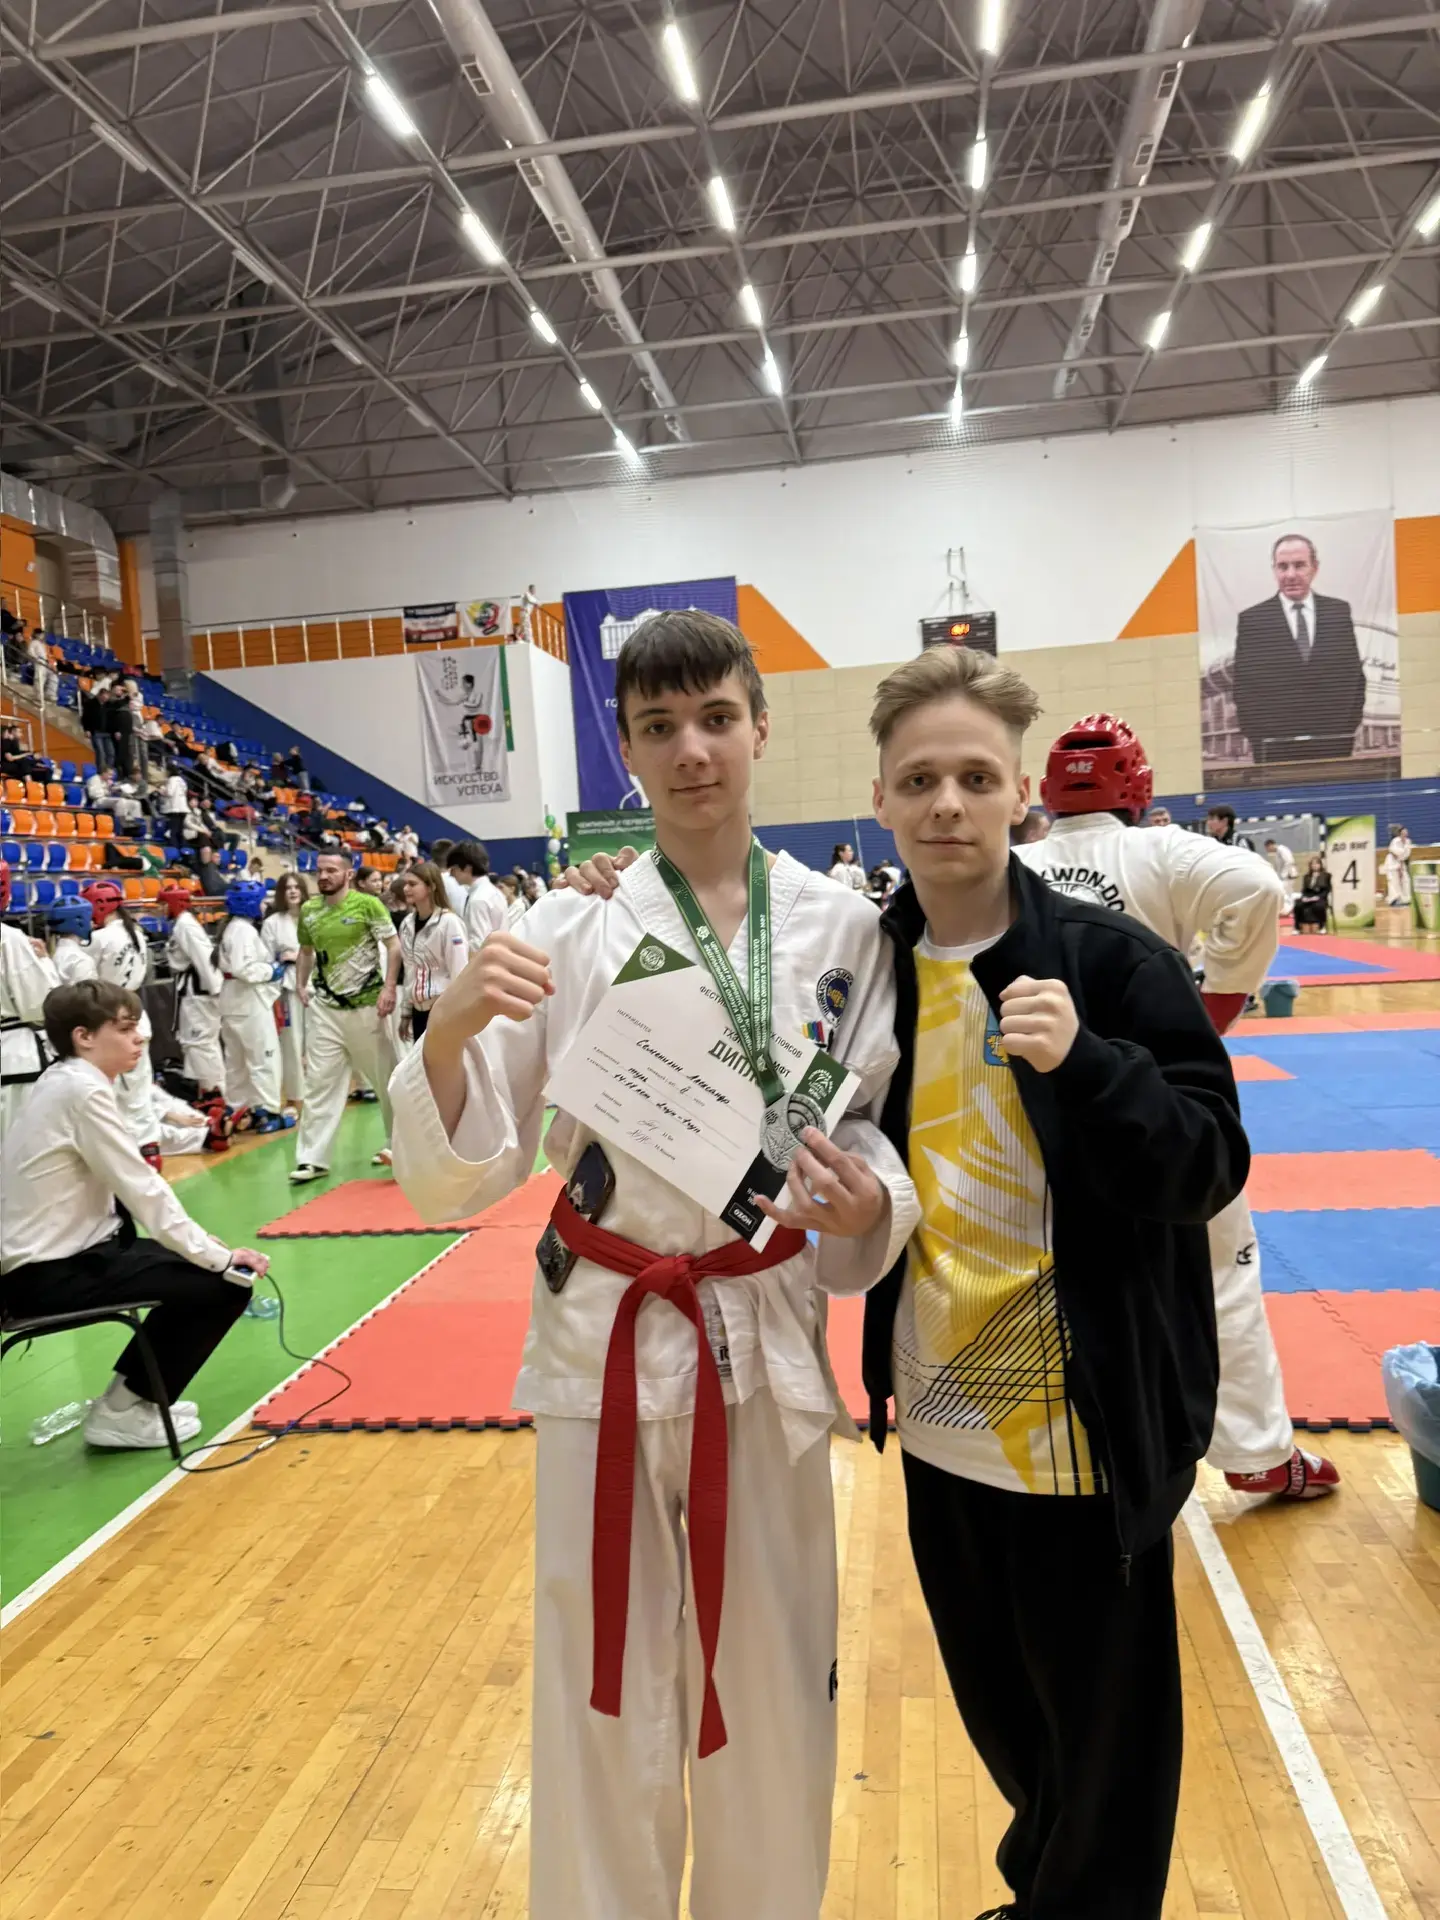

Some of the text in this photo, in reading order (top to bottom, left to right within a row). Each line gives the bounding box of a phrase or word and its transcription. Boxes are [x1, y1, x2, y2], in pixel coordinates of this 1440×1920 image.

[433, 771, 499, 785] ИСКУССТВО
[457, 782, 503, 797] УСПЕХА
[1341, 859, 1361, 890] 4
[773, 1035, 804, 1059] ПОЯСОВ
[769, 1060, 792, 1079] МФТ
